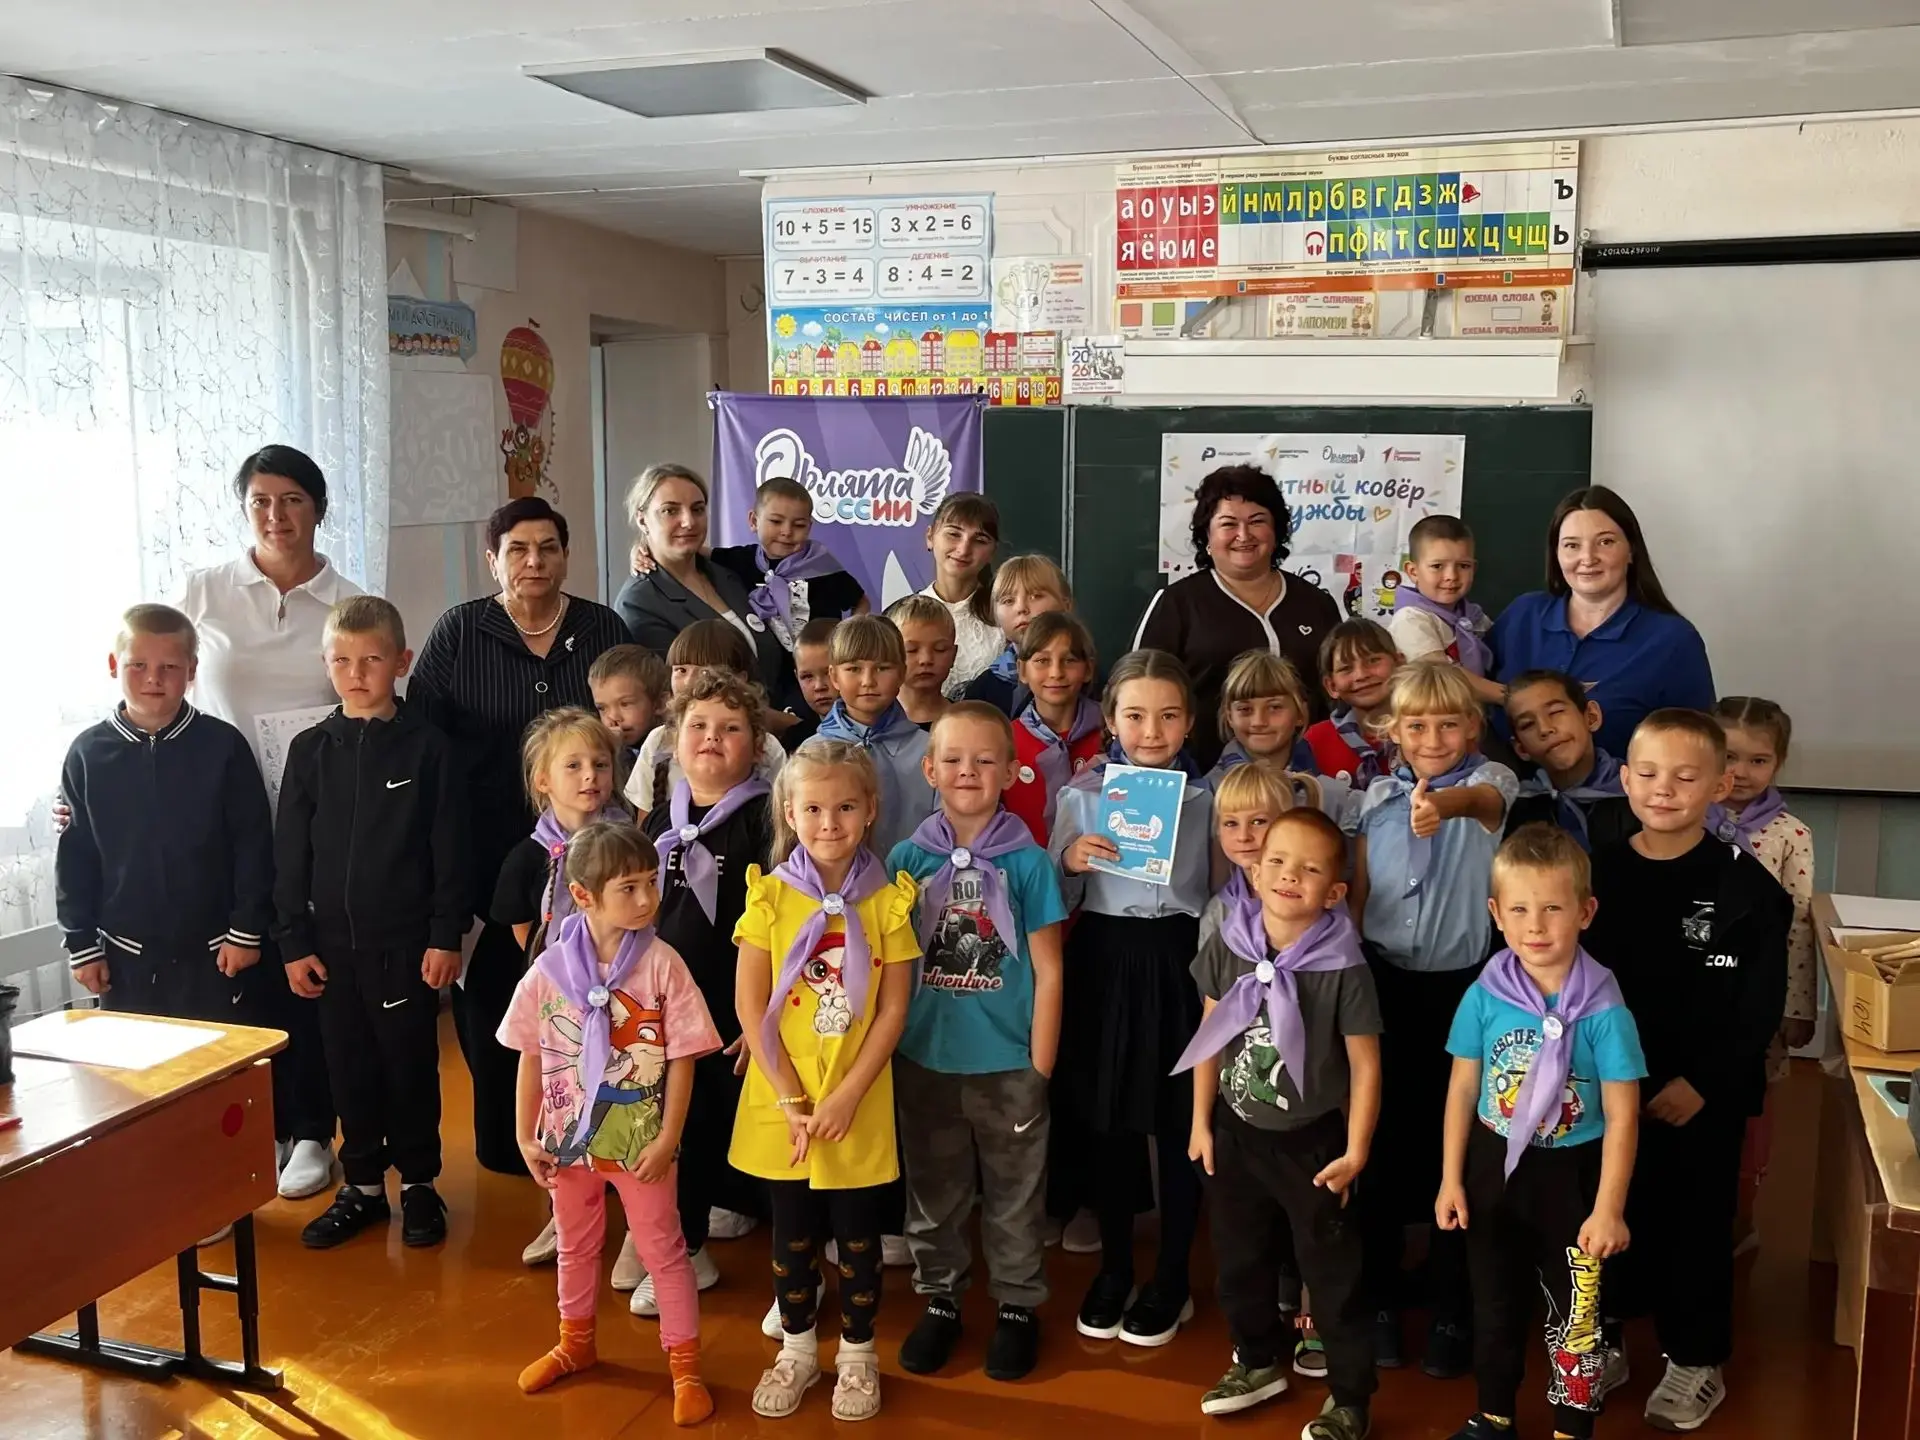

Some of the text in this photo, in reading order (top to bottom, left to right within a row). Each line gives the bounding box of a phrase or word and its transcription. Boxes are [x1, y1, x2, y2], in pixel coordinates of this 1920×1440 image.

[1222, 182, 1457, 218] й н м л р б в г д з ж
[1121, 194, 1215, 225] а о у ы э
[776, 220, 795, 236] 10
[819, 219, 828, 235] 5
[853, 218, 872, 234] 15
[891, 217, 901, 233] 3
[926, 215, 936, 231] 2
[961, 214, 971, 231] 6
[1121, 233, 1215, 262] я ё ю и е
[1329, 224, 1547, 260] п ф к т с ш х ц ч щ
[784, 269, 795, 285] 7
[816, 269, 826, 284] 3
[853, 267, 863, 283] 4
[888, 266, 899, 282] 8
[921, 265, 933, 281] 4
[961, 265, 973, 280] 2
[824, 312, 876, 323] СОСТАВ
[885, 312, 928, 322] ЧИСЕЛ
[933, 313, 946, 321] от
[951, 312, 956, 321] 1
[961, 312, 977, 321] до
[1072, 351, 1089, 363] 20
[1072, 364, 1089, 377] 26
[989, 382, 1000, 398] 16
[1003, 383, 1015, 399] 17
[1018, 382, 1030, 398] 18
[1033, 381, 1044, 398] 19
[1047, 382, 1059, 398] 20
[1355, 478, 1425, 508] ковёр
